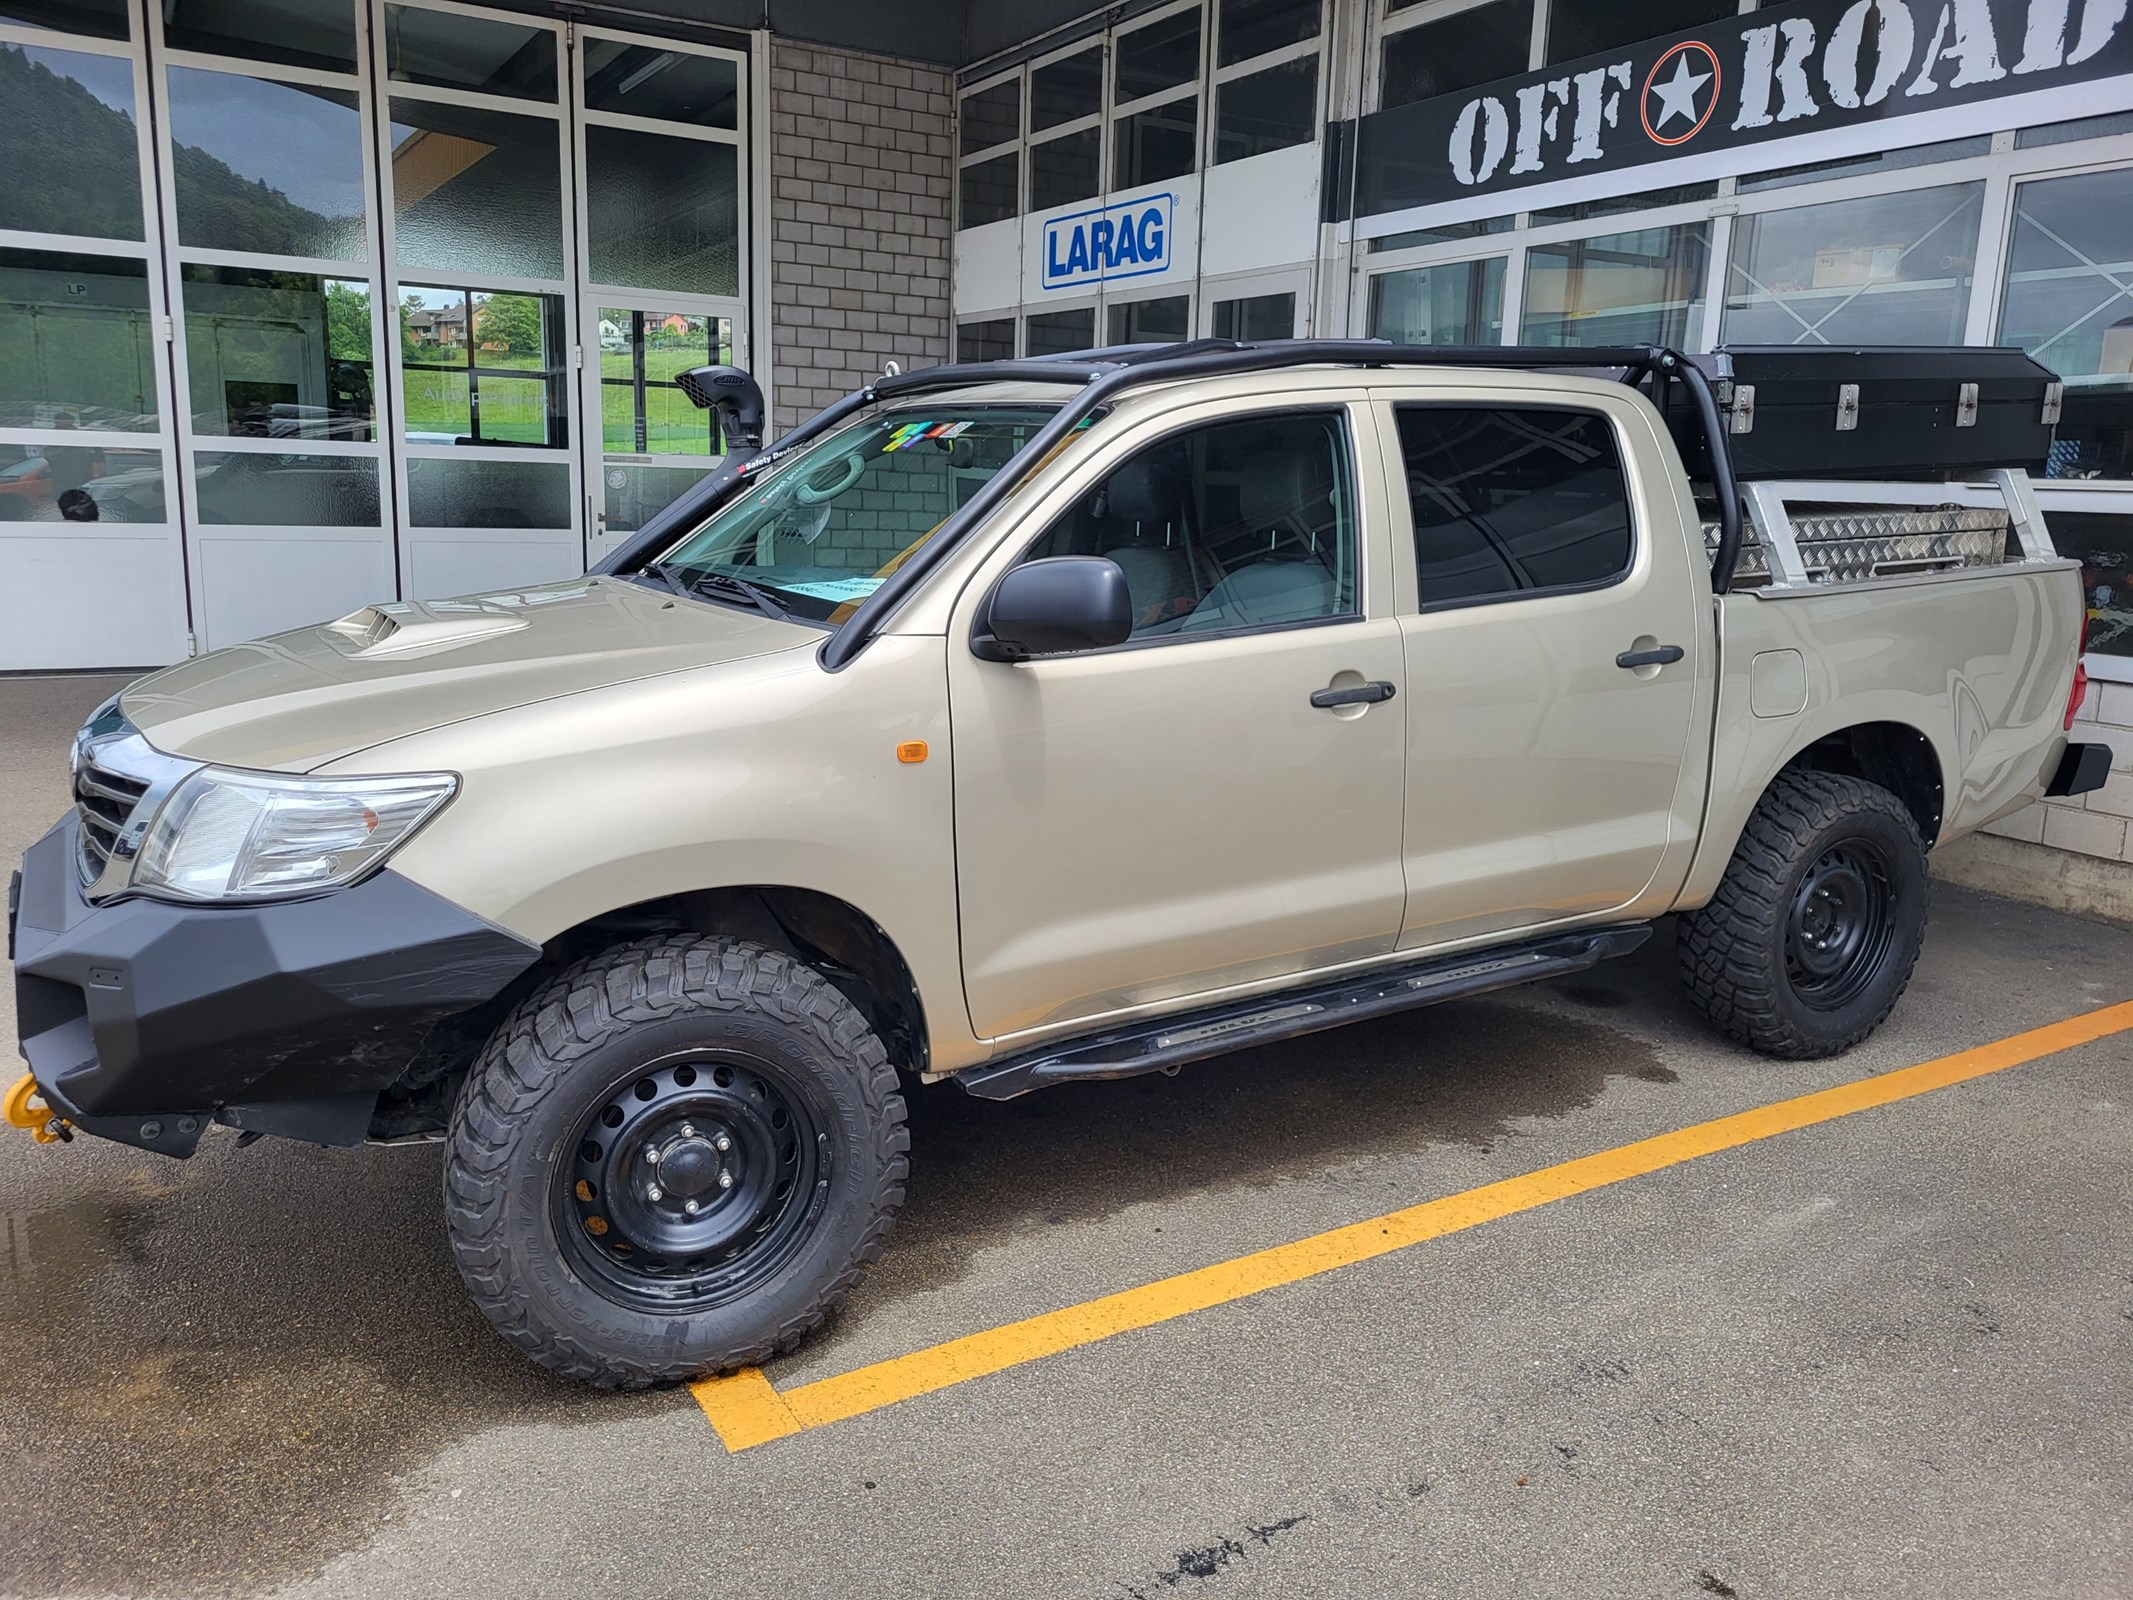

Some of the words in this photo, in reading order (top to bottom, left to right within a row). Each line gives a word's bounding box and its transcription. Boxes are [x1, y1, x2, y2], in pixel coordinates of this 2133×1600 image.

[1449, 60, 1632, 185] OFF
[1731, 0, 2129, 131] ROAD
[1048, 207, 1163, 278] LARAG
[67, 284, 86, 295] LP
[745, 455, 771, 470] Safety
[726, 1022, 864, 1195] BFGoodrich
